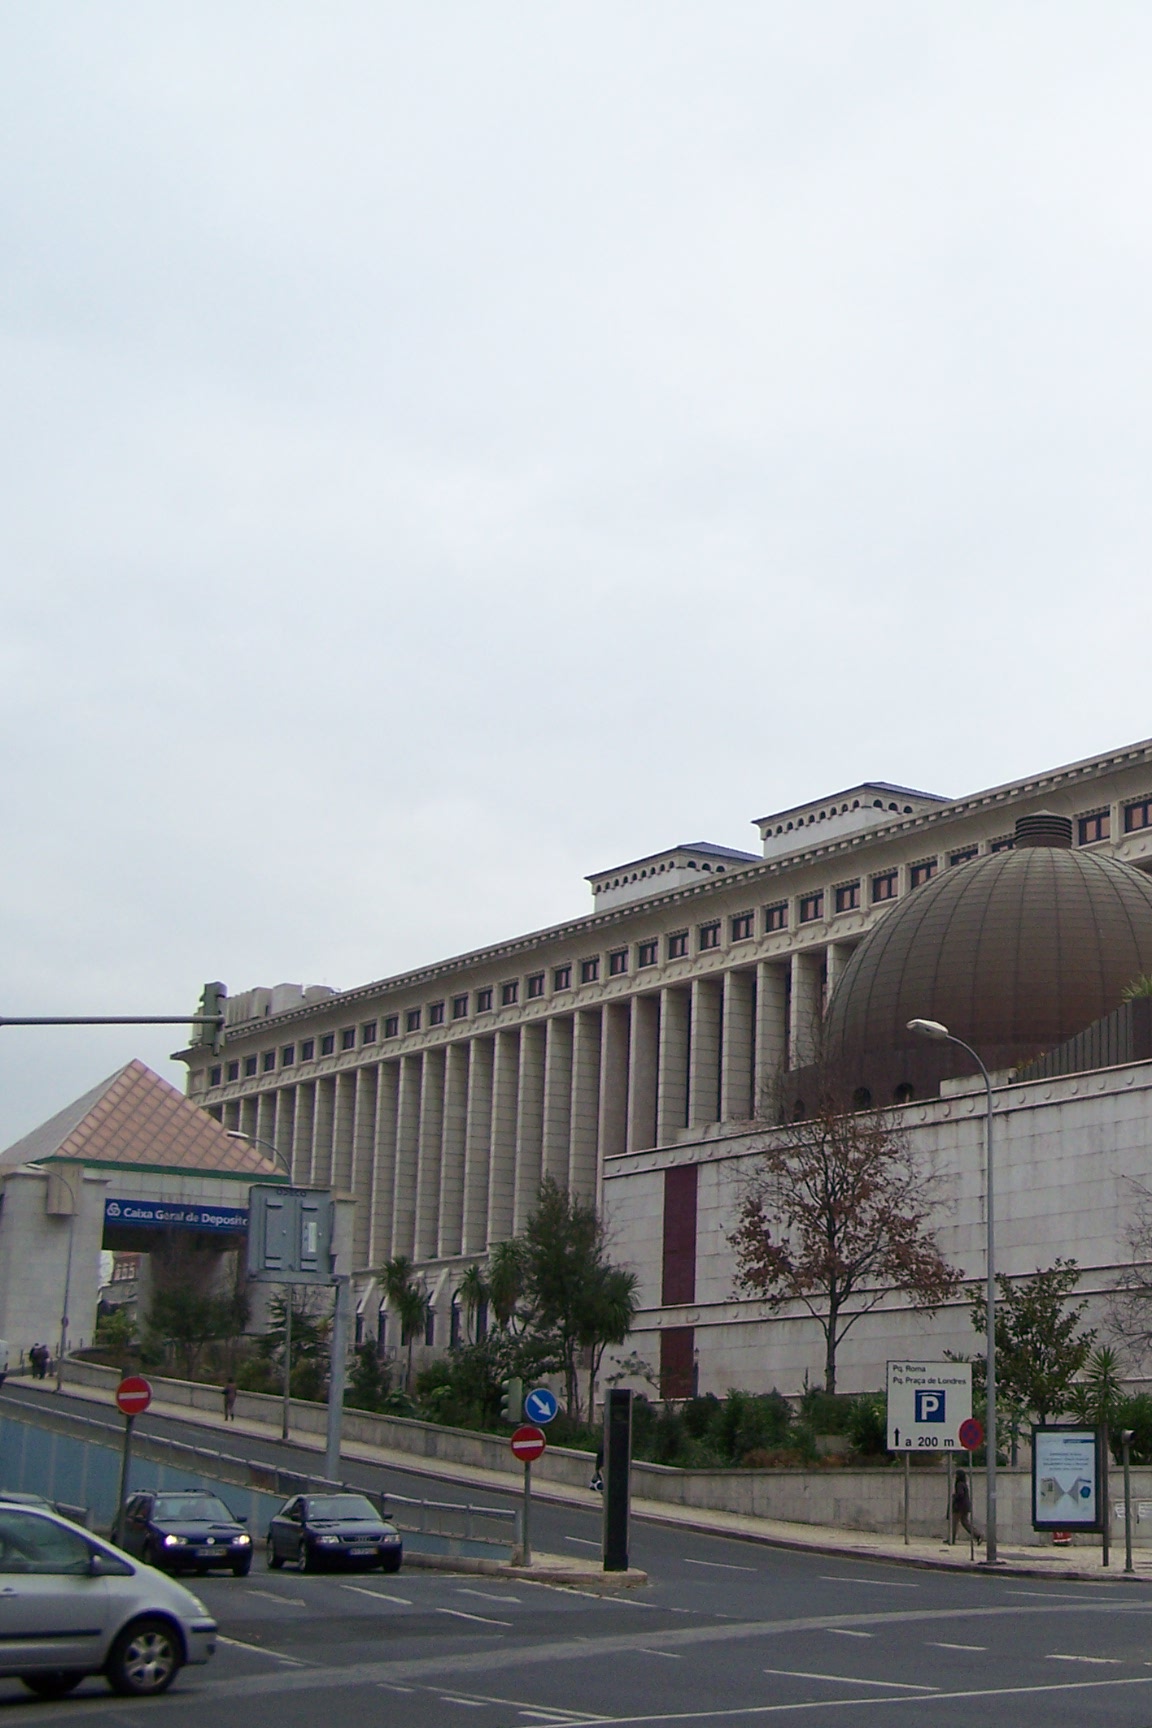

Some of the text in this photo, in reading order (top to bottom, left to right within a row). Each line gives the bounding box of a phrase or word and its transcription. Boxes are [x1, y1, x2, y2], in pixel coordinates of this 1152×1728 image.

[123, 1207, 153, 1219] Caixa
[155, 1209, 184, 1221] Geral
[186, 1211, 199, 1222] de
[905, 1364, 926, 1373] Roma
[905, 1377, 926, 1386] Praça
[927, 1377, 937, 1385] de
[937, 1377, 967, 1385] Londres
[921, 1395, 940, 1421] P
[905, 1436, 954, 1447] a 200 m
